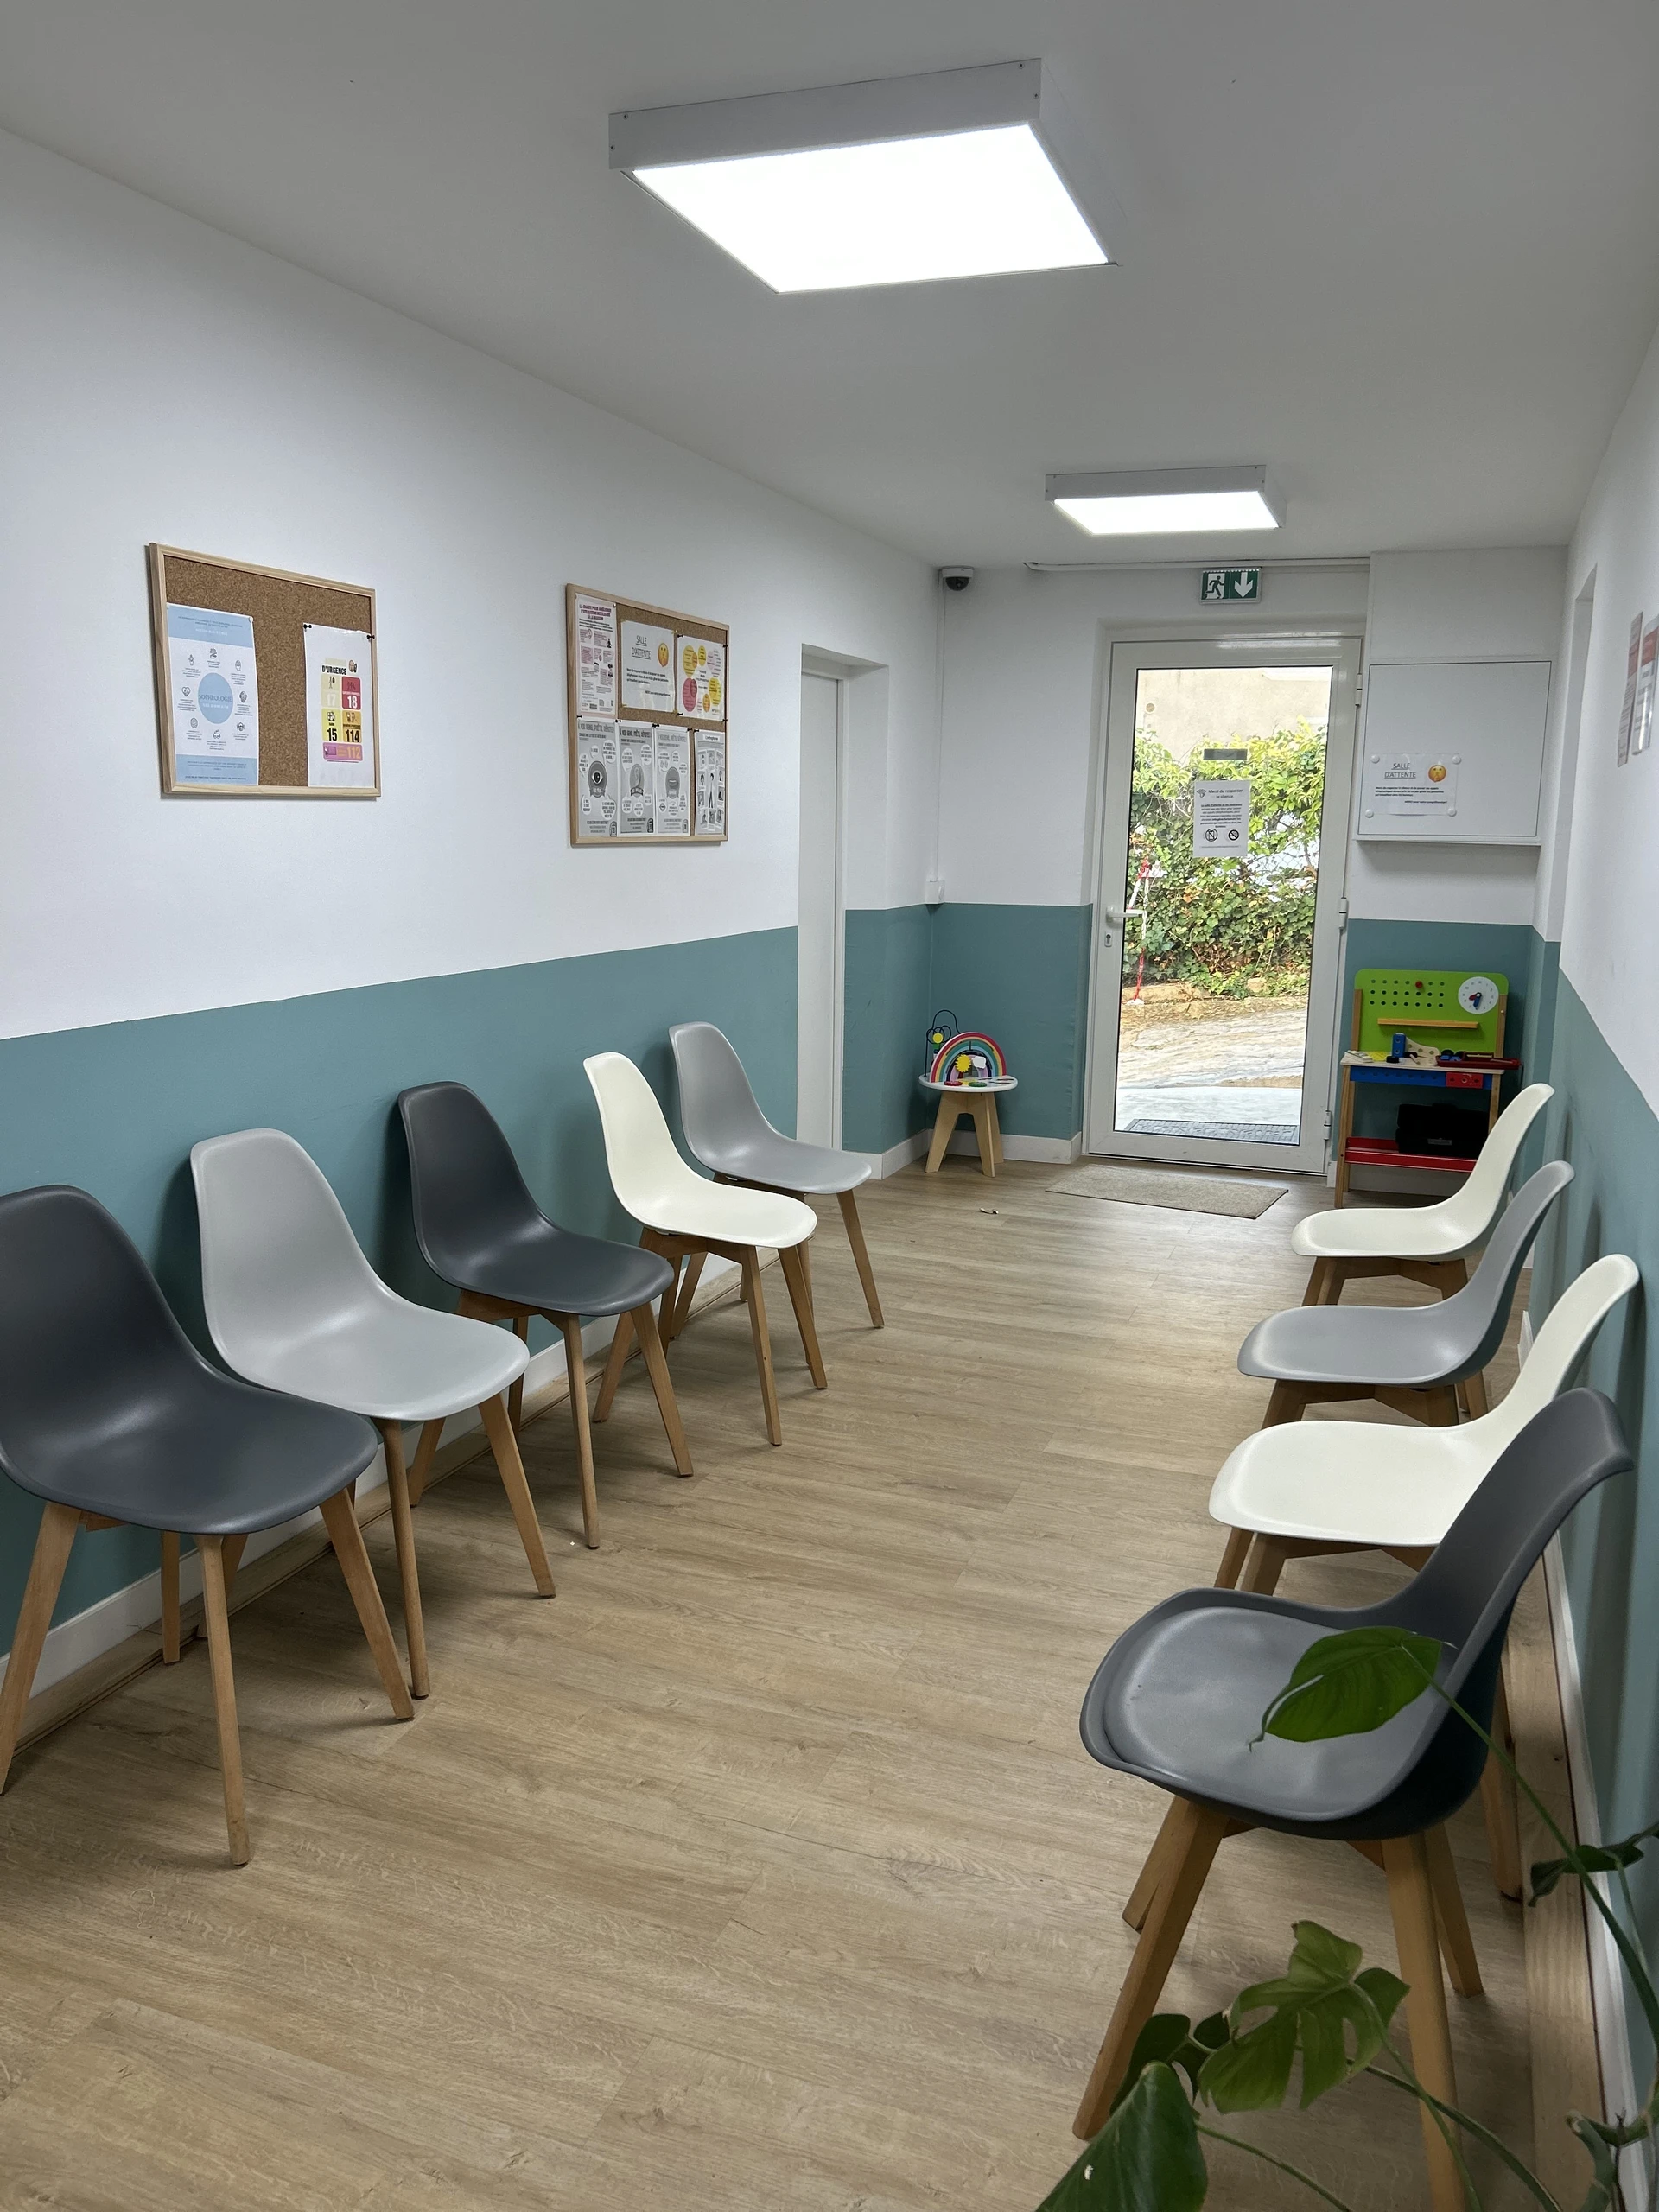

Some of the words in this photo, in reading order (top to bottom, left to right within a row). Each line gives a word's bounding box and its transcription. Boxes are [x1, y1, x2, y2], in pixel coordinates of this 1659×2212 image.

[636, 635, 647, 645] SALLE
[321, 664, 347, 676] D'URGENCE
[198, 694, 232, 702] SOPHROLOGIE
[346, 695, 358, 709] 18
[327, 728, 337, 741] 15
[346, 729, 360, 743] 114
[346, 747, 361, 760] 112
